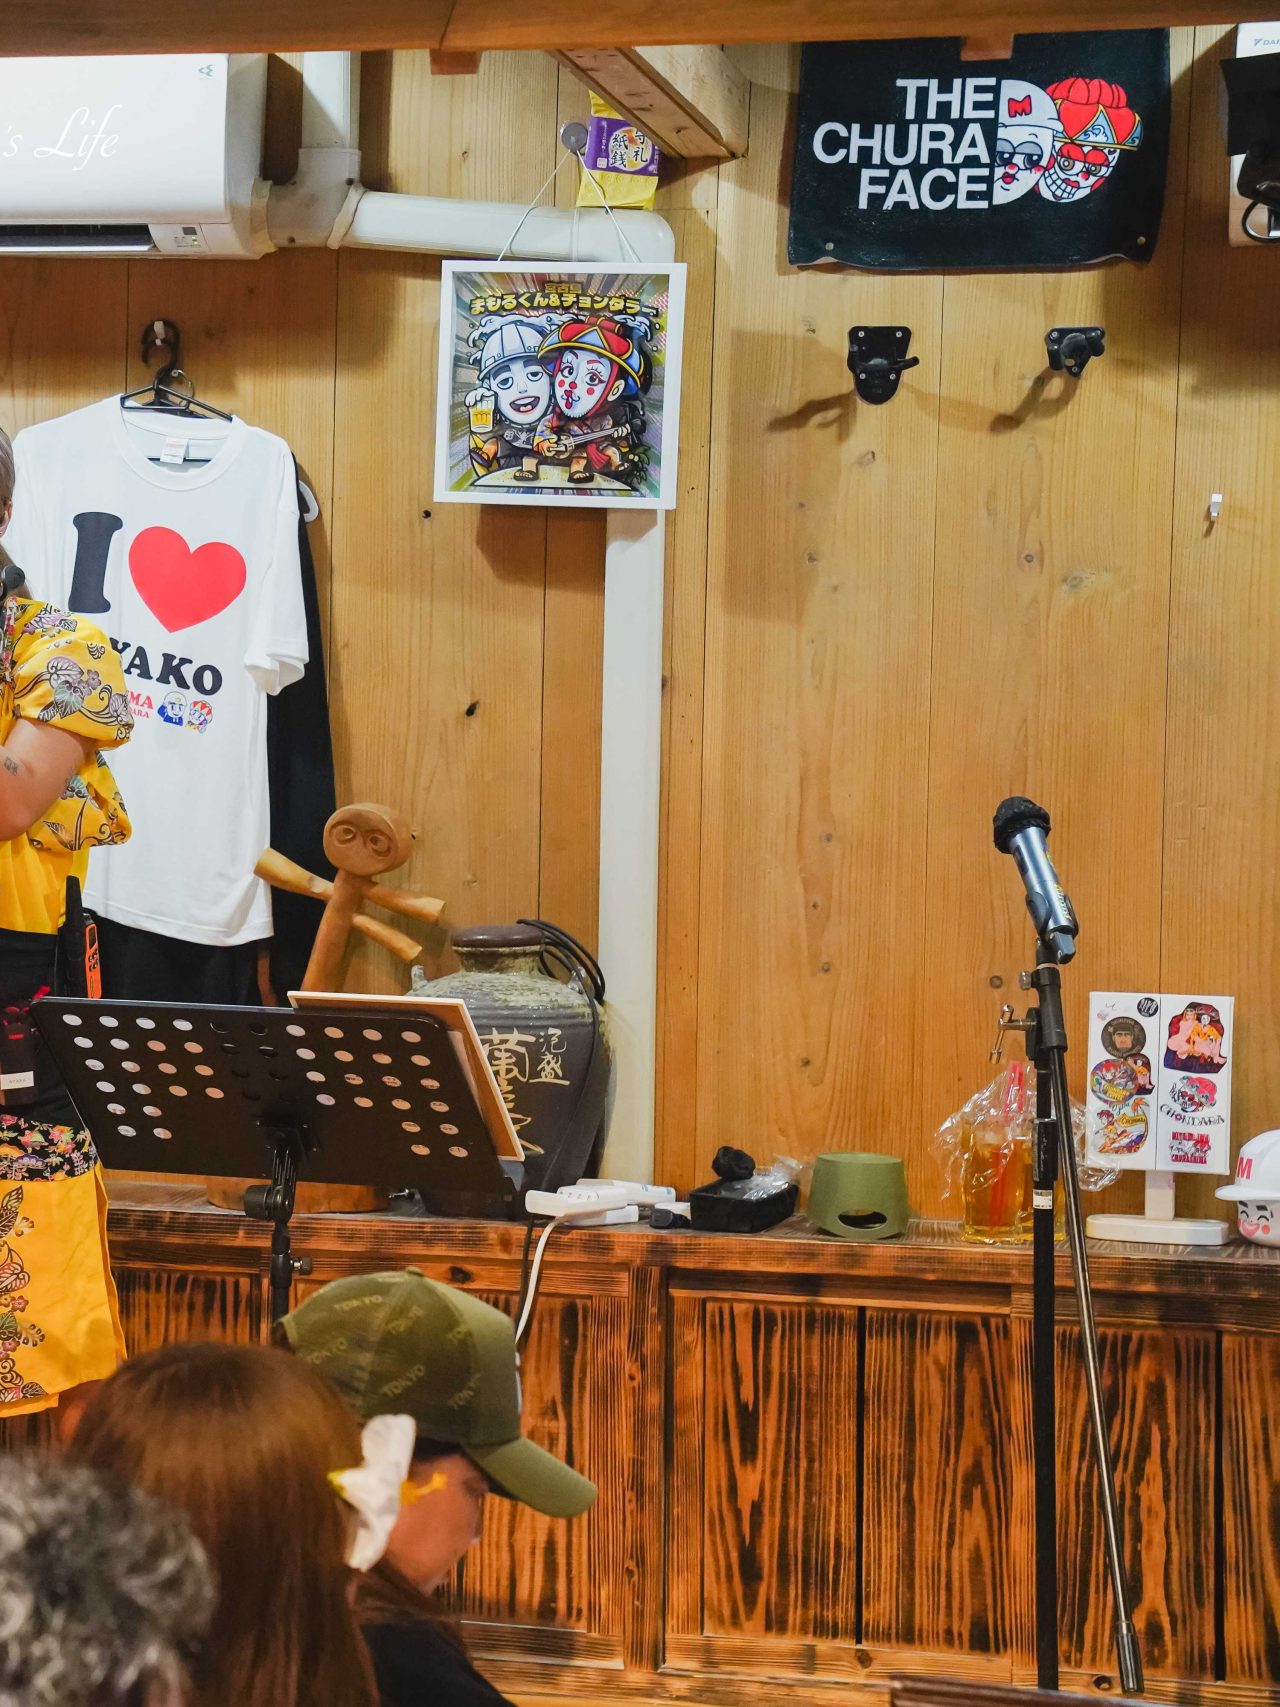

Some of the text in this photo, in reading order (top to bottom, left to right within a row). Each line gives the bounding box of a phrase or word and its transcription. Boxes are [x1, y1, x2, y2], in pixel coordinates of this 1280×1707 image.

[896, 77, 997, 119] THE
[1007, 94, 1032, 118] M
[33, 104, 123, 171] Life
[812, 122, 991, 164] CHURA
[857, 167, 990, 210] FACE
[68, 511, 123, 614] I
[109, 637, 223, 696] YAKO
[528, 1027, 570, 1086] 泡盛
[1237, 1156, 1253, 1180] M
[380, 1364, 426, 1398] TOKYO
